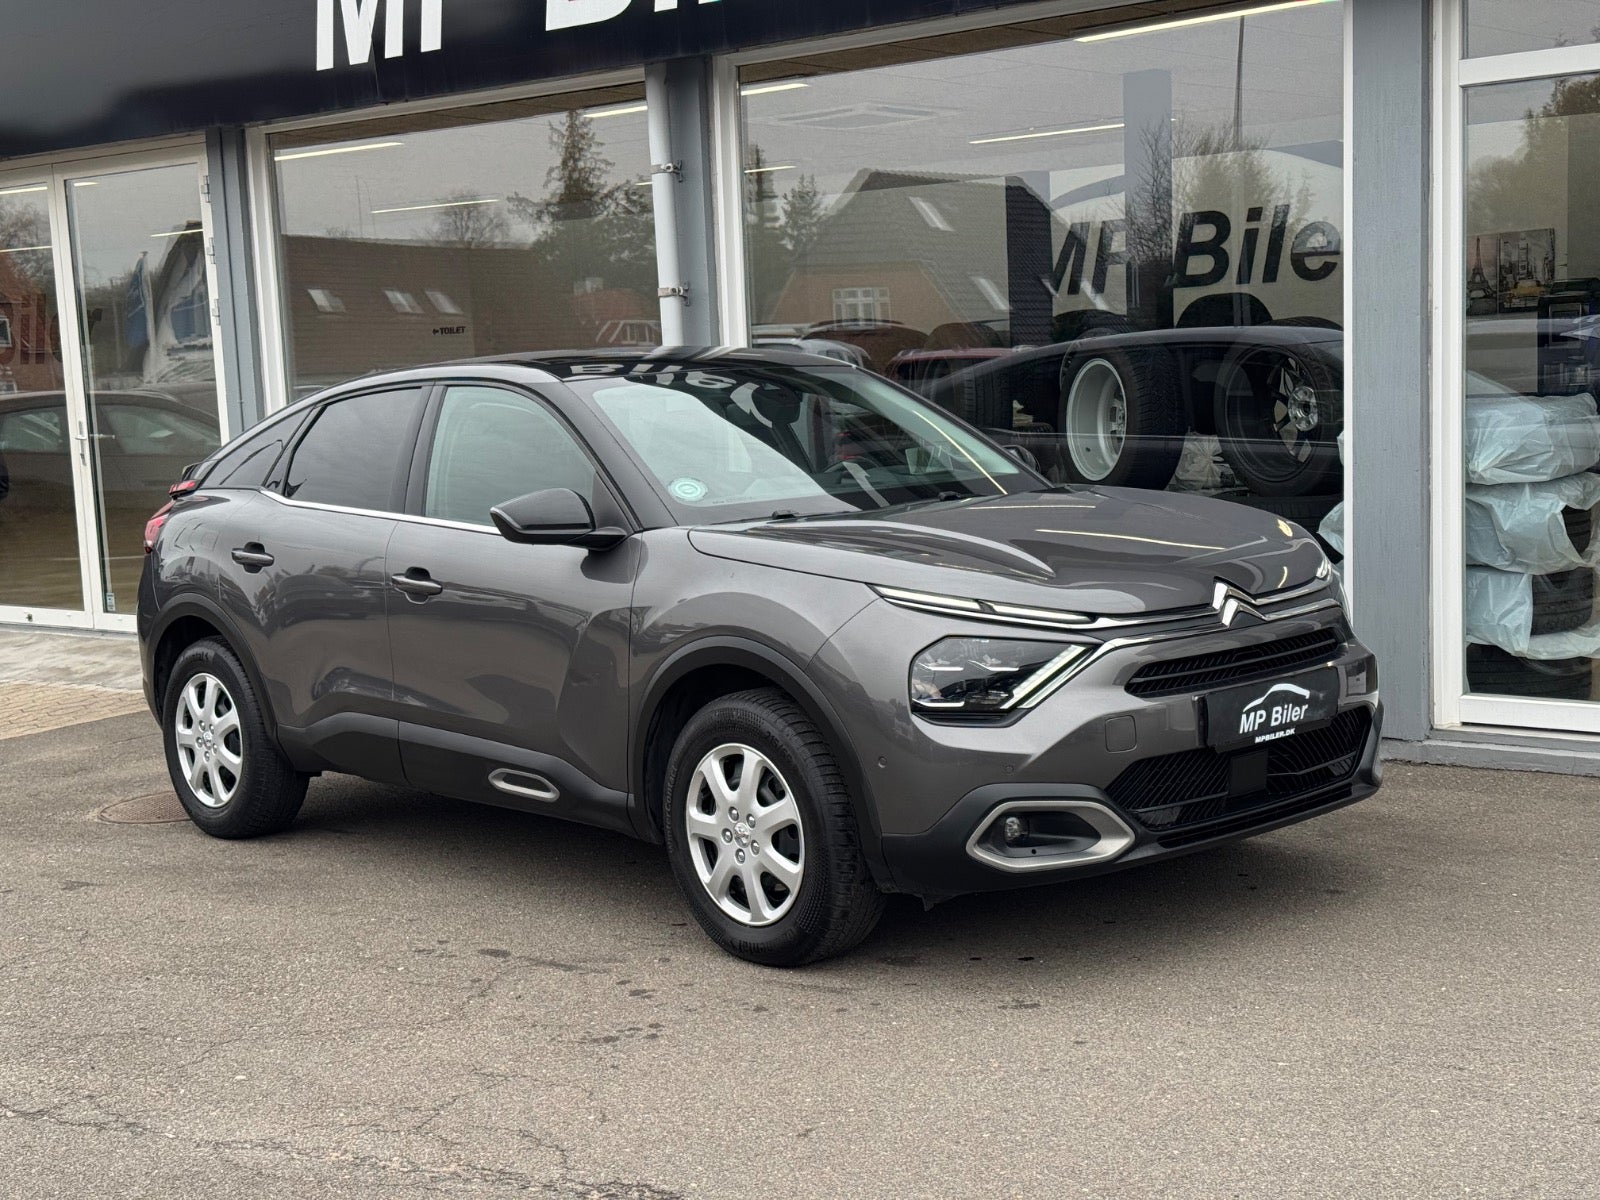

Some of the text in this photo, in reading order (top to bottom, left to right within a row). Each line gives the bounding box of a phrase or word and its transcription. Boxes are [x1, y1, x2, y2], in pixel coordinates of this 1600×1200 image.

[440, 326, 466, 335] TOILET
[1239, 703, 1309, 734] MP Biler
[1254, 727, 1296, 744] MPBILER.DK
